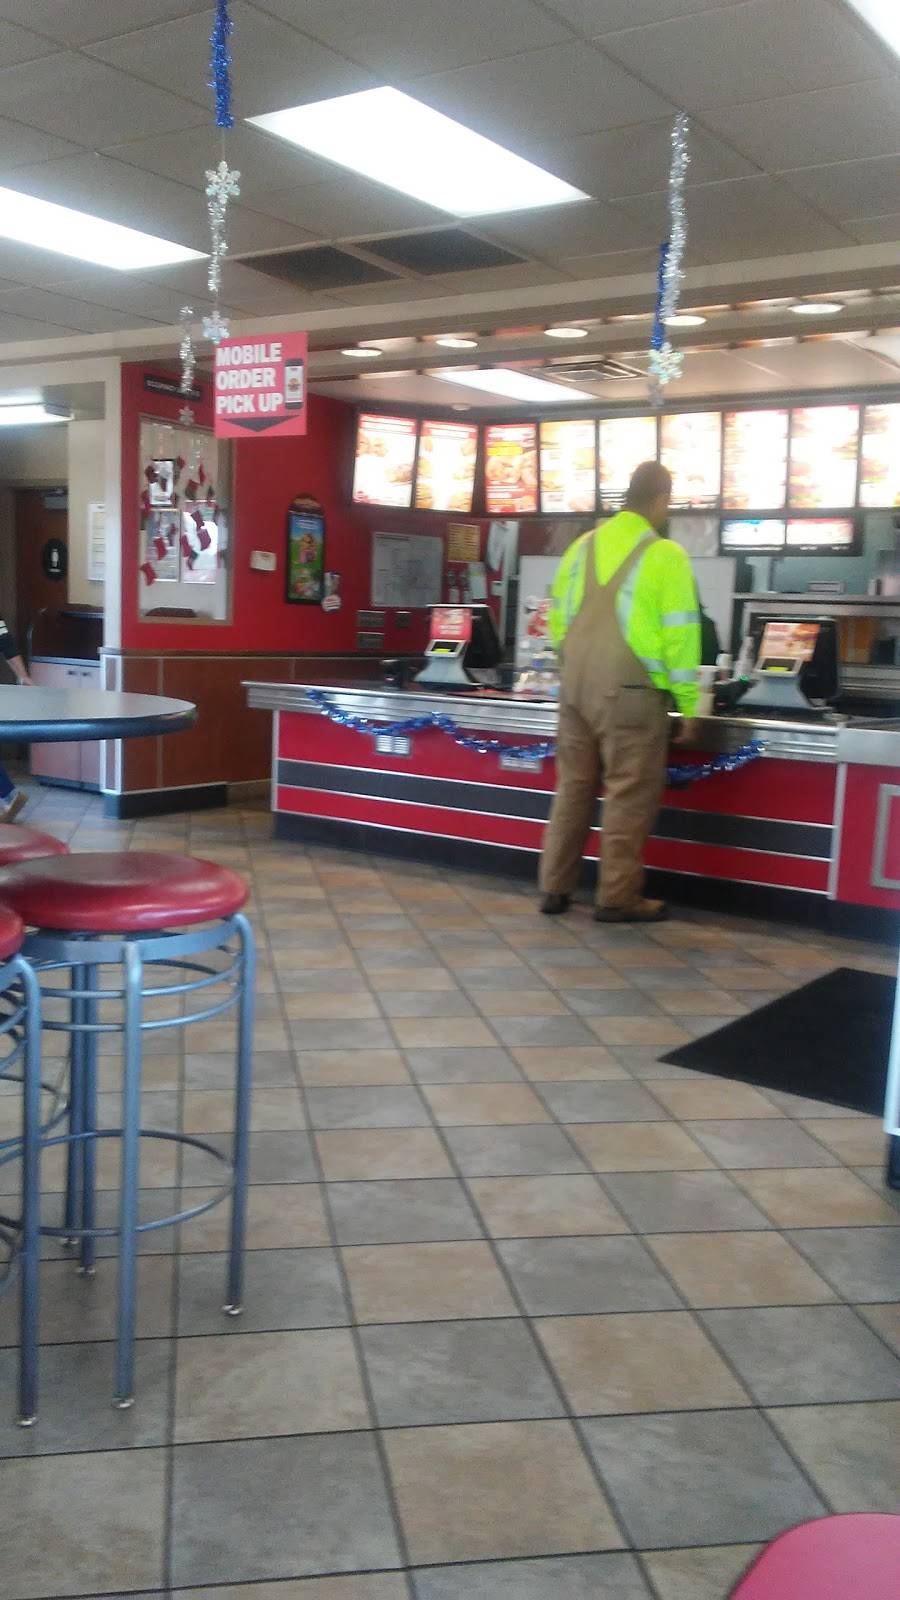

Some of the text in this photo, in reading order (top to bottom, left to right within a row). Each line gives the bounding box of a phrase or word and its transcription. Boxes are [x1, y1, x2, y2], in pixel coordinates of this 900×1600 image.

[216, 342, 282, 366] MOBILE
[216, 367, 276, 390] ORDER
[216, 392, 283, 414] PICK UP
